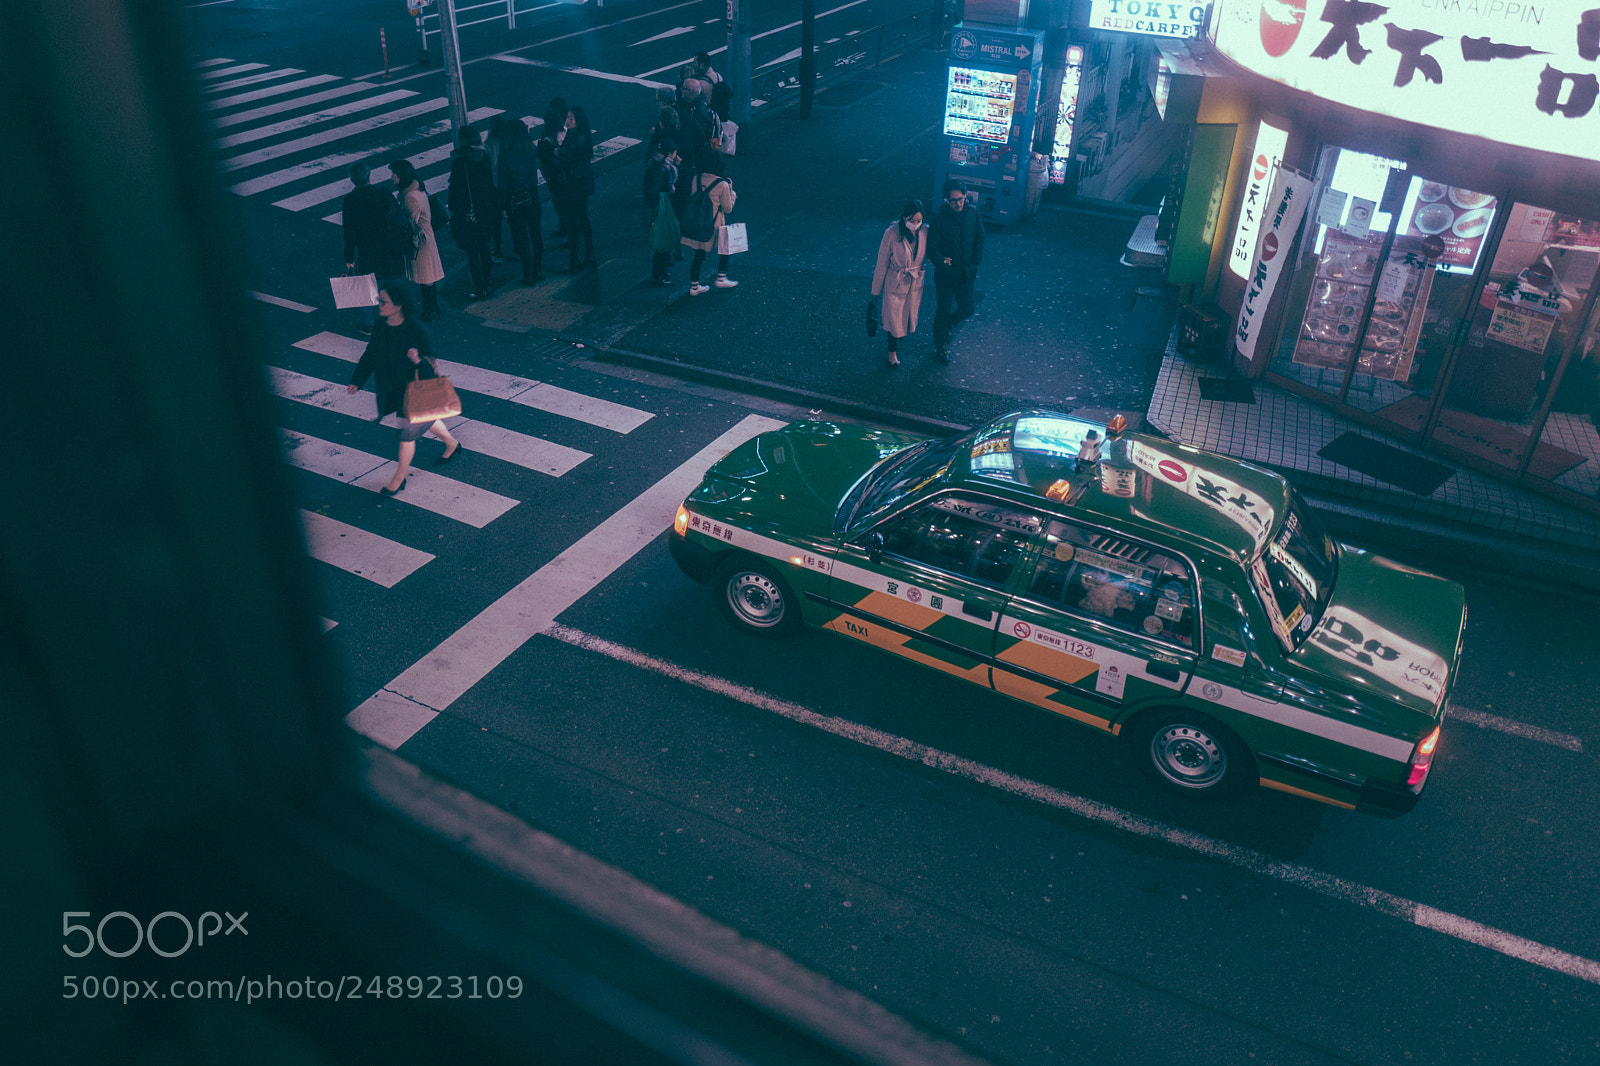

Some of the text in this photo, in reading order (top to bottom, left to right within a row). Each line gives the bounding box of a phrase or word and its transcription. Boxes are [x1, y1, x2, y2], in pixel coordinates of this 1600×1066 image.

[981, 44, 1012, 56] MISTRAL
[1236, 183, 1260, 261] 天下一品
[692, 516, 733, 541] 東京無線
[844, 620, 868, 637] TAXI
[1063, 640, 1093, 658] 1123
